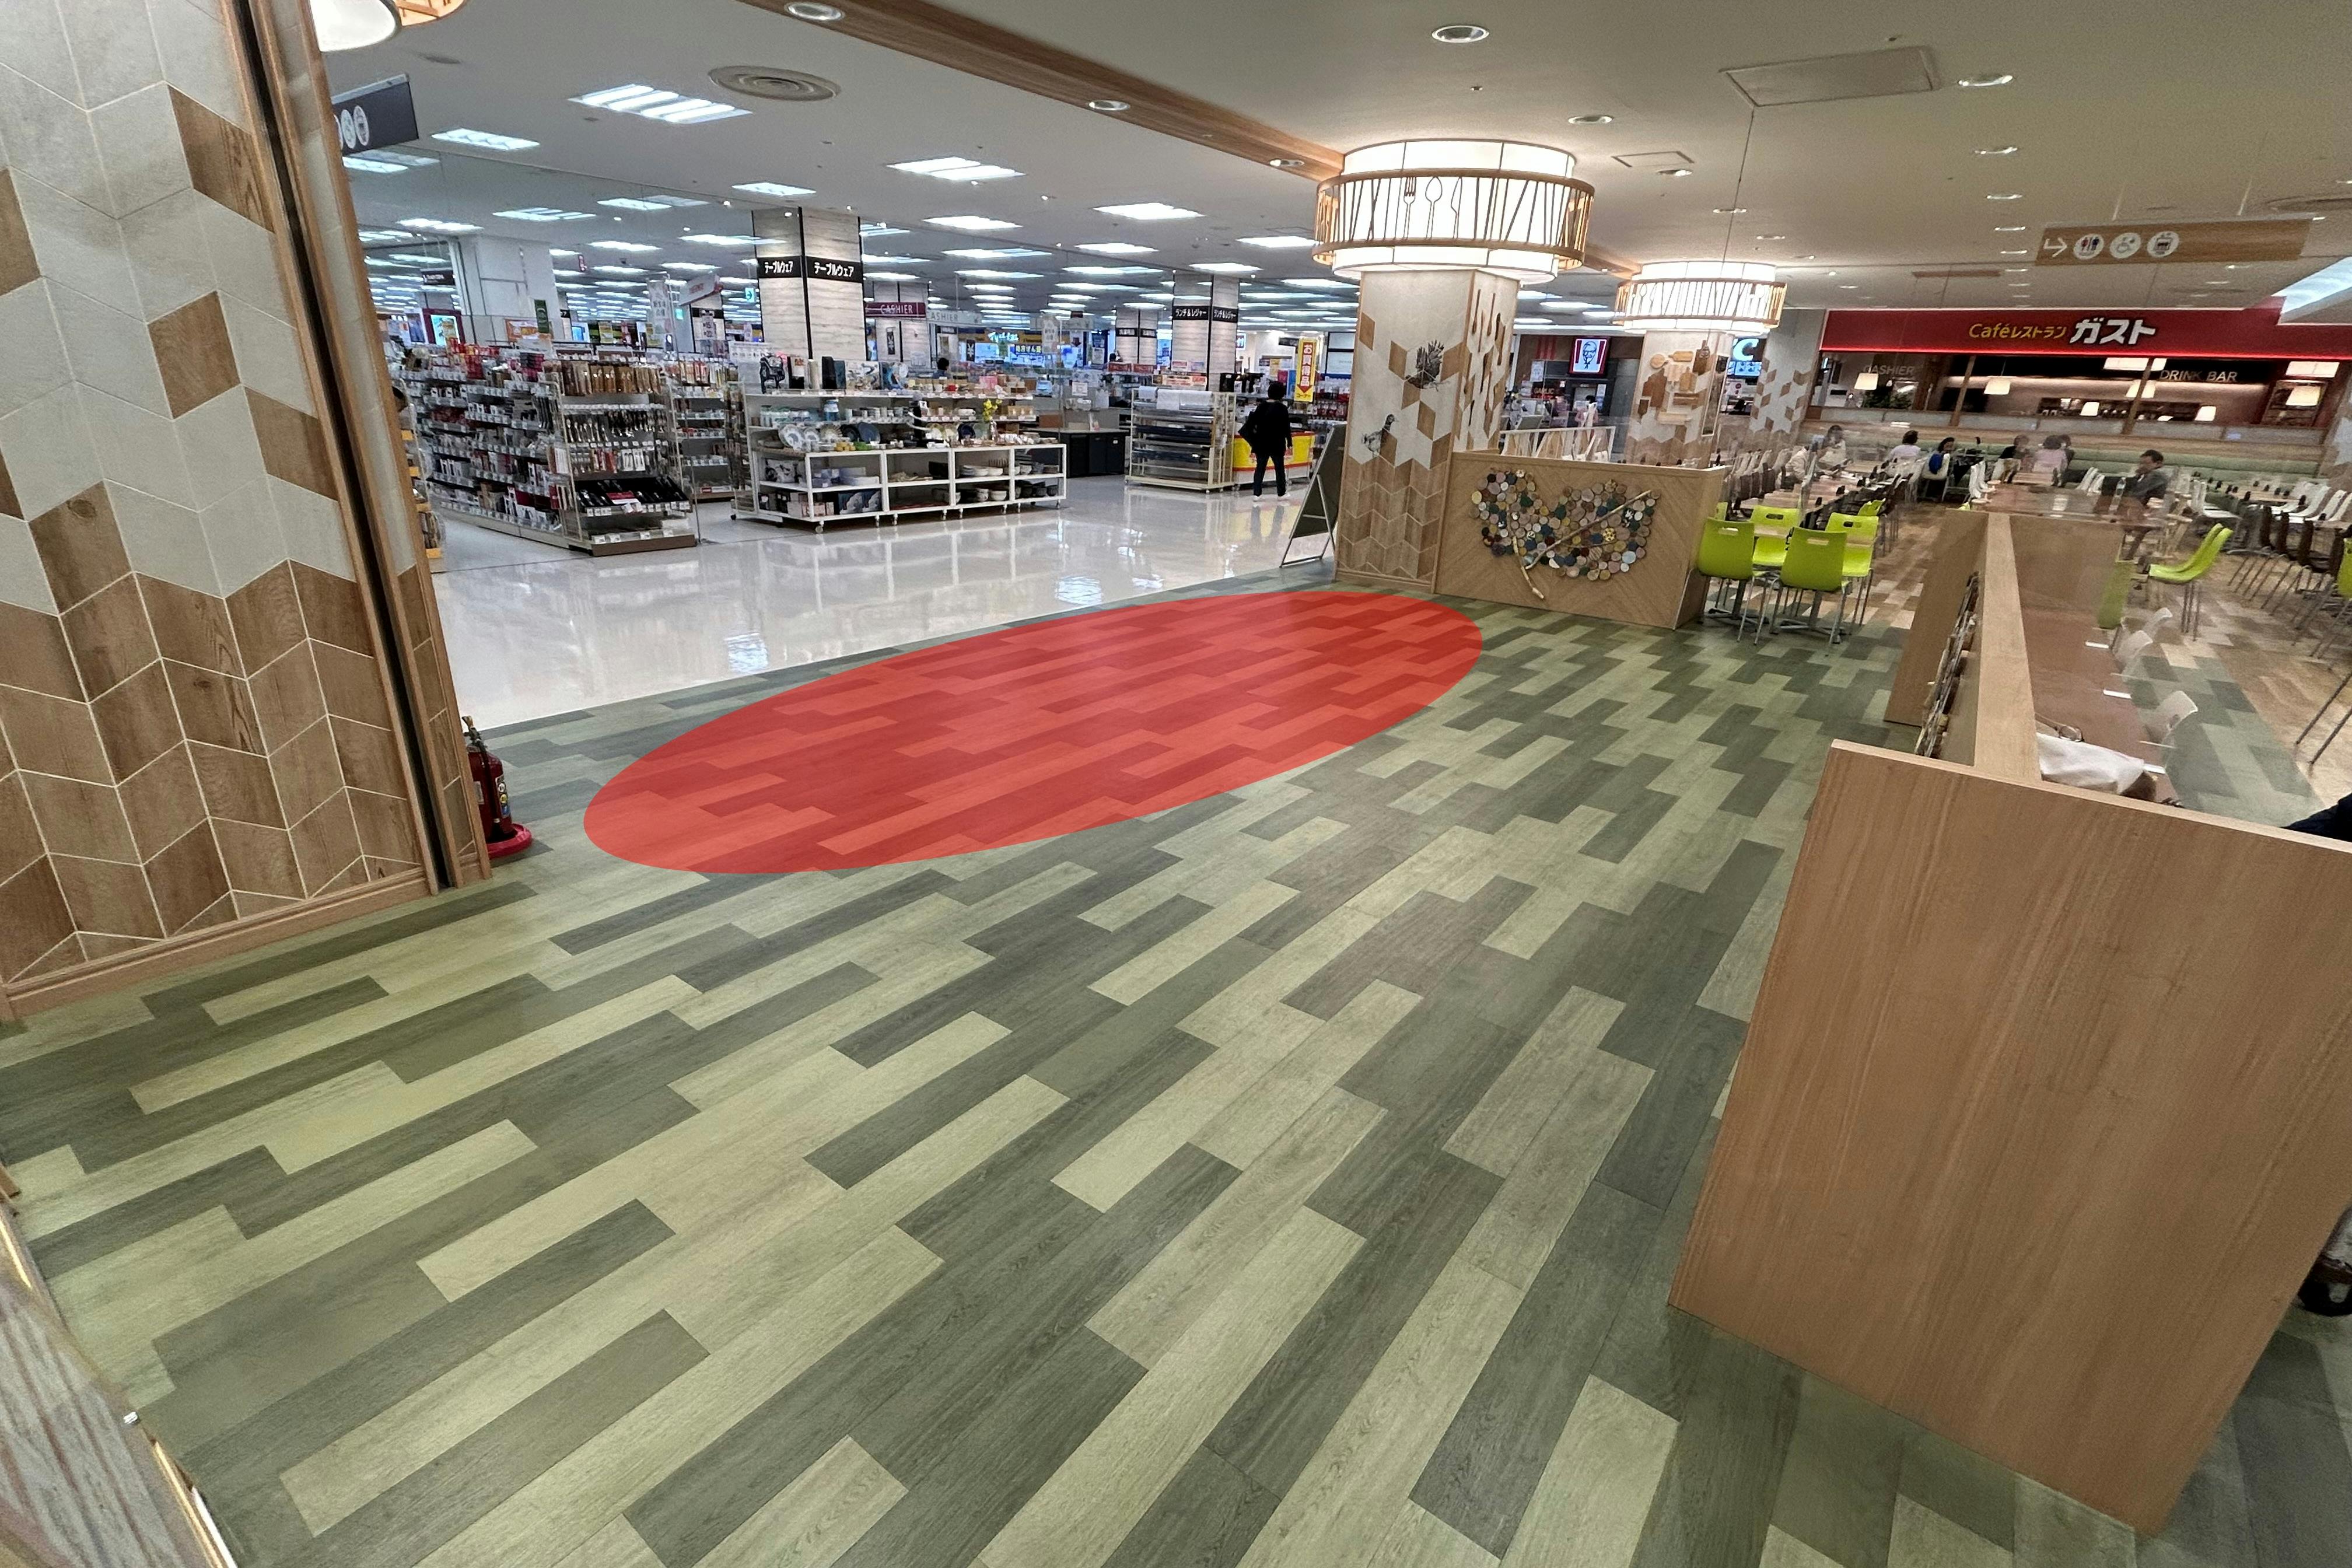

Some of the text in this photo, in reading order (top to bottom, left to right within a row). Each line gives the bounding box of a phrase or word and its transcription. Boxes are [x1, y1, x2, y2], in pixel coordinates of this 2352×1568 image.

[765, 261, 794, 274] テーブルウェア
[814, 262, 855, 278] テーブルウェア
[880, 304, 913, 314] CASHIER
[2069, 317, 2157, 345] ガスト
[1863, 363, 1916, 376] CASHIER
[2159, 369, 2238, 383] DRINK BAR
